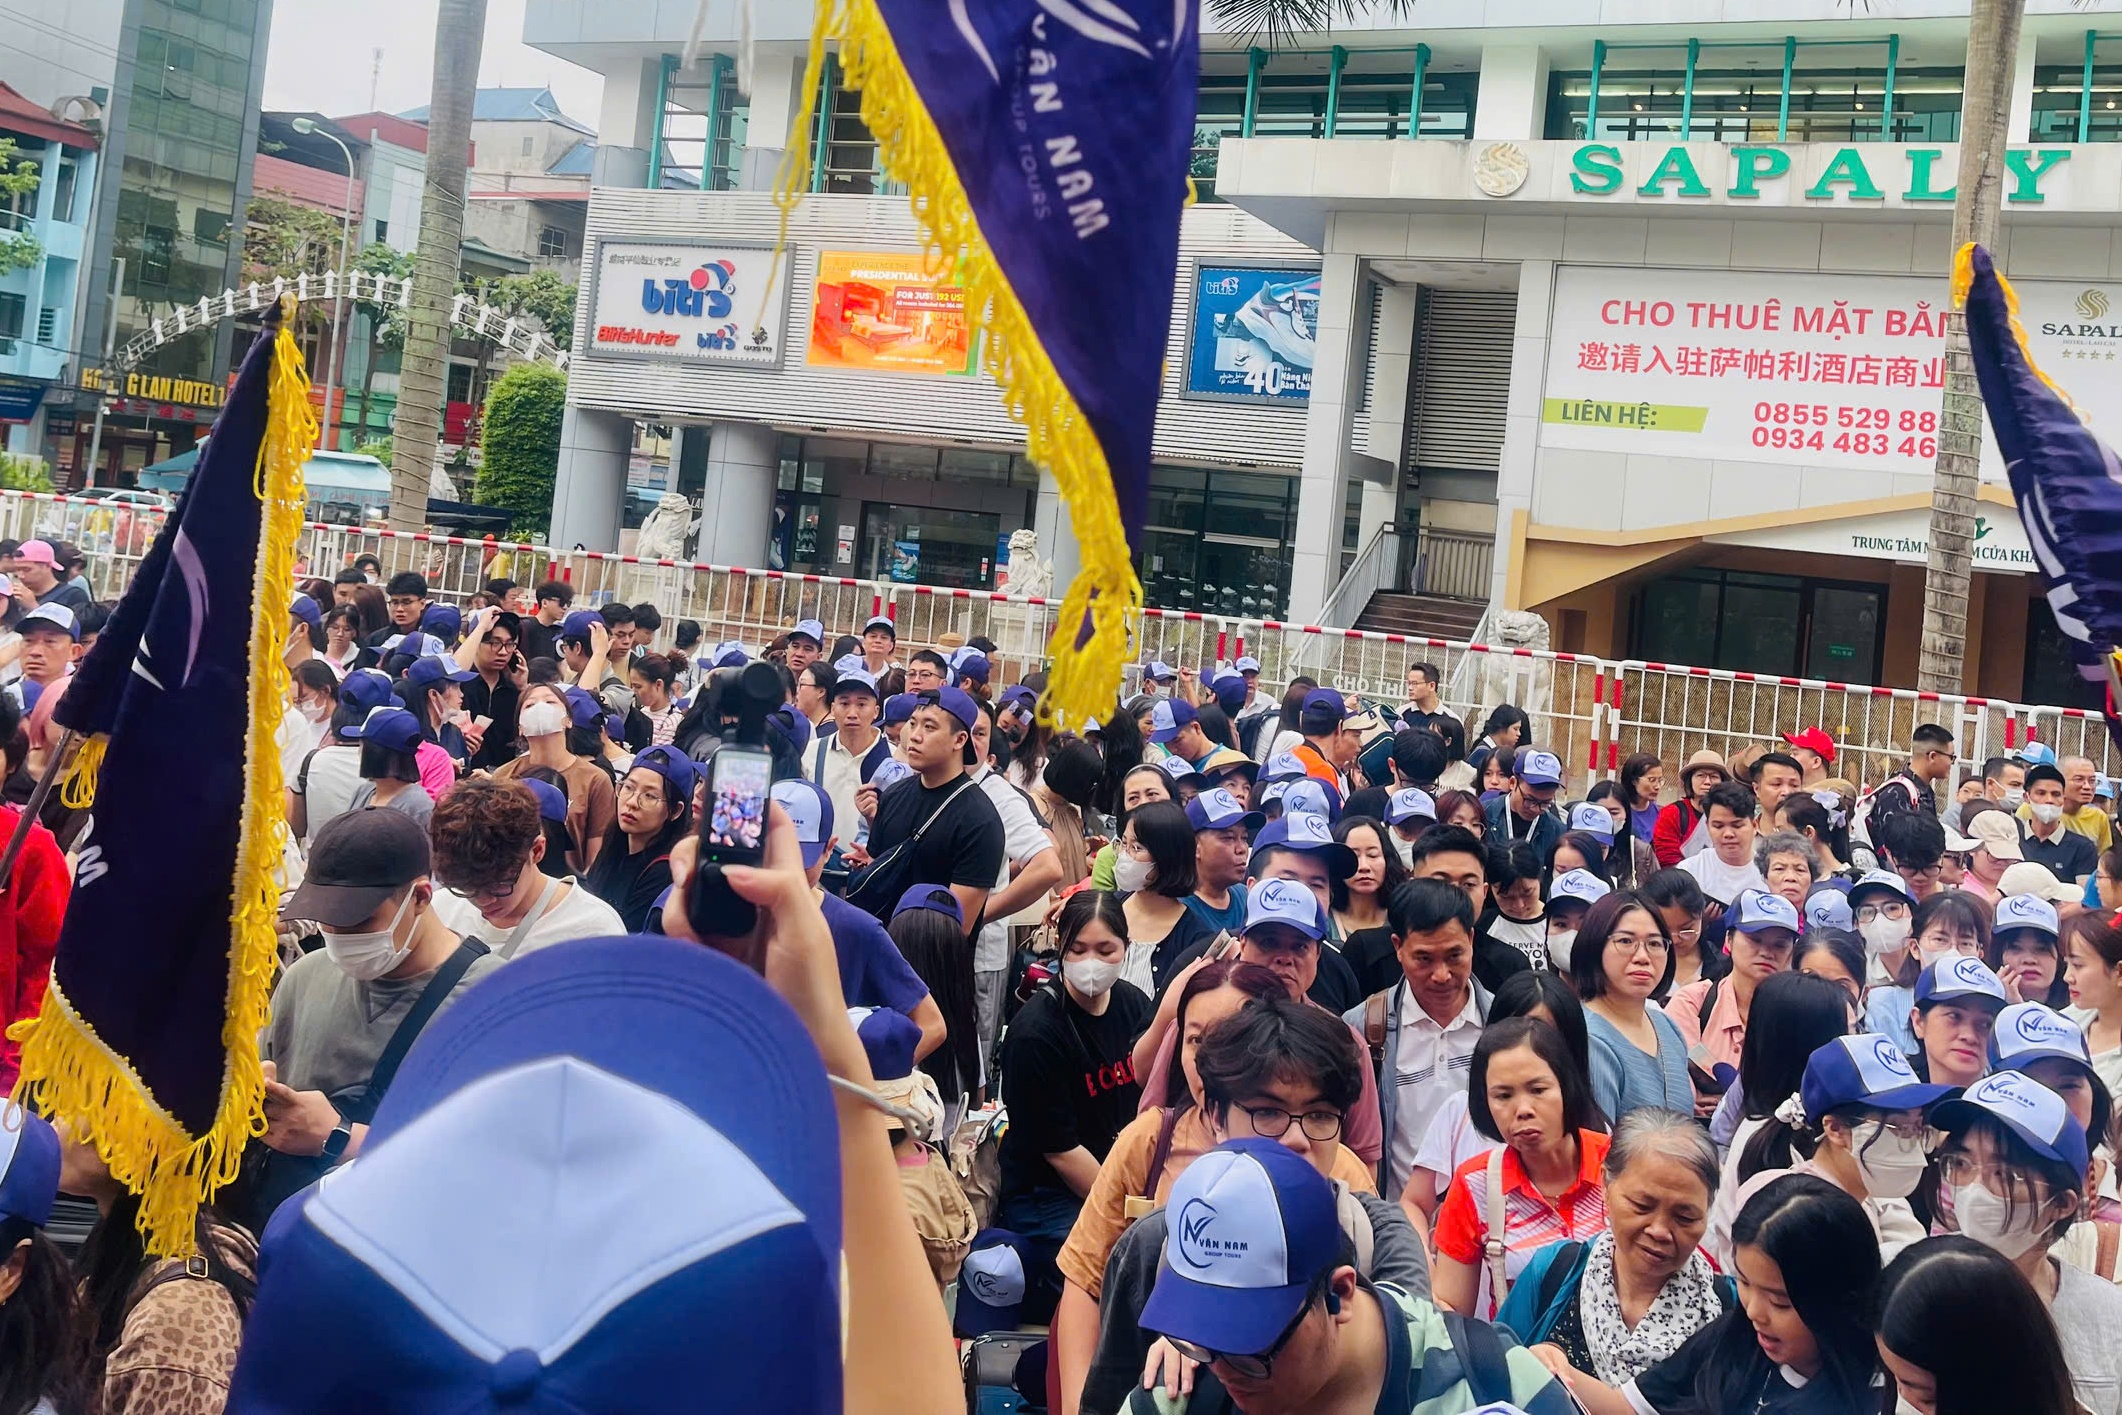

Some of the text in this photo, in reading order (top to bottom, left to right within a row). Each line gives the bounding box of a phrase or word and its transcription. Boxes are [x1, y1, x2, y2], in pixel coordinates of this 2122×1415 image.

[1045, 135, 1110, 240] NAM
[1568, 144, 2072, 203] SAPALY
[850, 270, 919, 282] PRESIDENTIAL
[896, 291, 913, 299] FOR
[1600, 299, 1675, 325] CHO
[1686, 298, 1781, 332] THUÊ
[1792, 300, 1875, 342] MẶT
[1244, 361, 1285, 395] 40
[1577, 342, 1946, 388] 邀请入驻萨帕利酒店商业
[140, 375, 171, 400] LAN
[172, 380, 216, 406] HOTEL
[1561, 398, 1658, 430] LIÊN HỆ:
[1753, 401, 1829, 427] 0855
[1837, 405, 1891, 430] 529
[1751, 426, 1826, 451] 0934
[1832, 430, 1890, 456] 483
[1851, 535, 1893, 551] TRUNG
[1895, 537, 1921, 553] TÂM
[1982, 544, 2007, 561] CỬA
[1199, 1237, 1249, 1251] VÂN NAM
